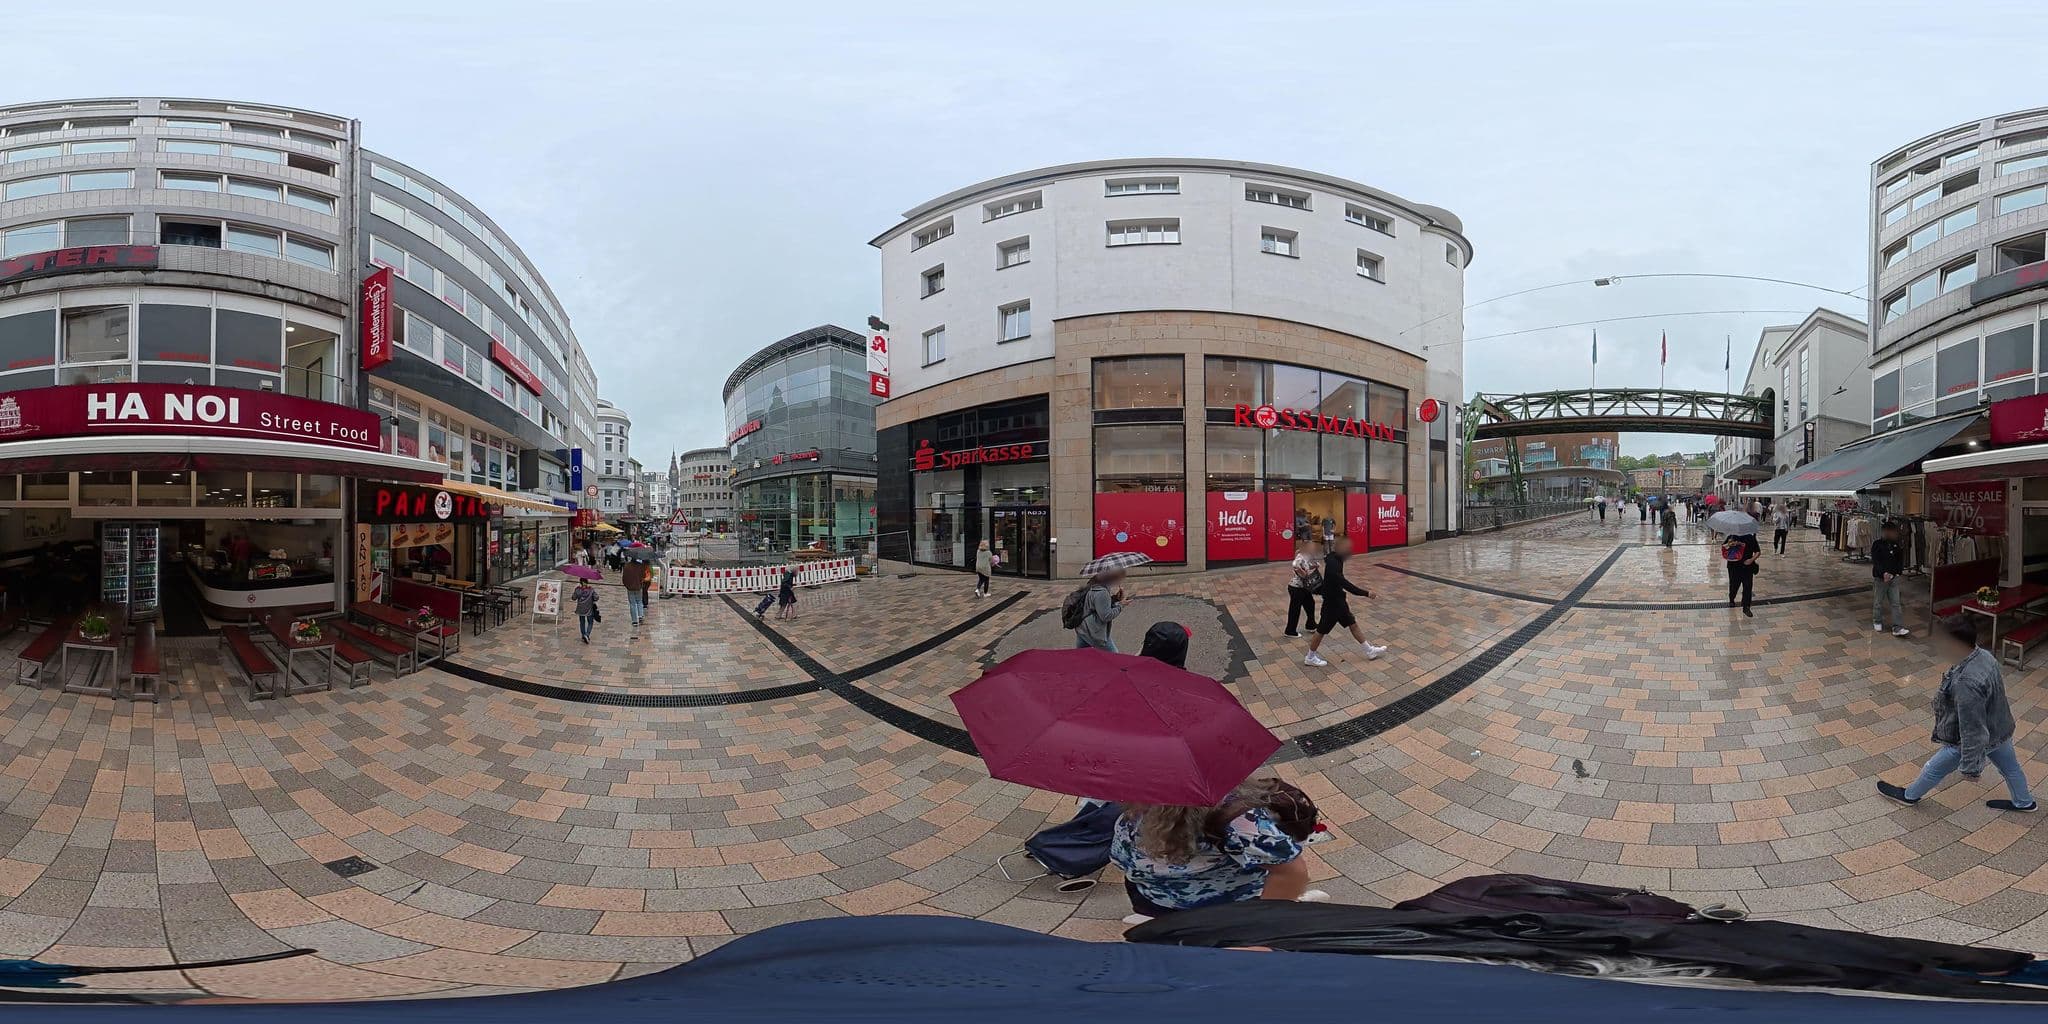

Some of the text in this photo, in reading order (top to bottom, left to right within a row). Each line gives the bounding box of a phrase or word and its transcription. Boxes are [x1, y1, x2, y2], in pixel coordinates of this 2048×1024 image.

[370, 290, 381, 356] Studienkreis
[88, 392, 369, 441] HA NOI Street Food
[1234, 403, 1395, 442] ROSSMANN
[941, 442, 1033, 469] Sparkasse
[376, 489, 428, 517] PAN
[1931, 490, 2003, 503] SALE SALE SALE
[1218, 509, 1254, 527] Hallo
[1378, 505, 1400, 520] Hallo
[1943, 504, 1984, 528] 70%
